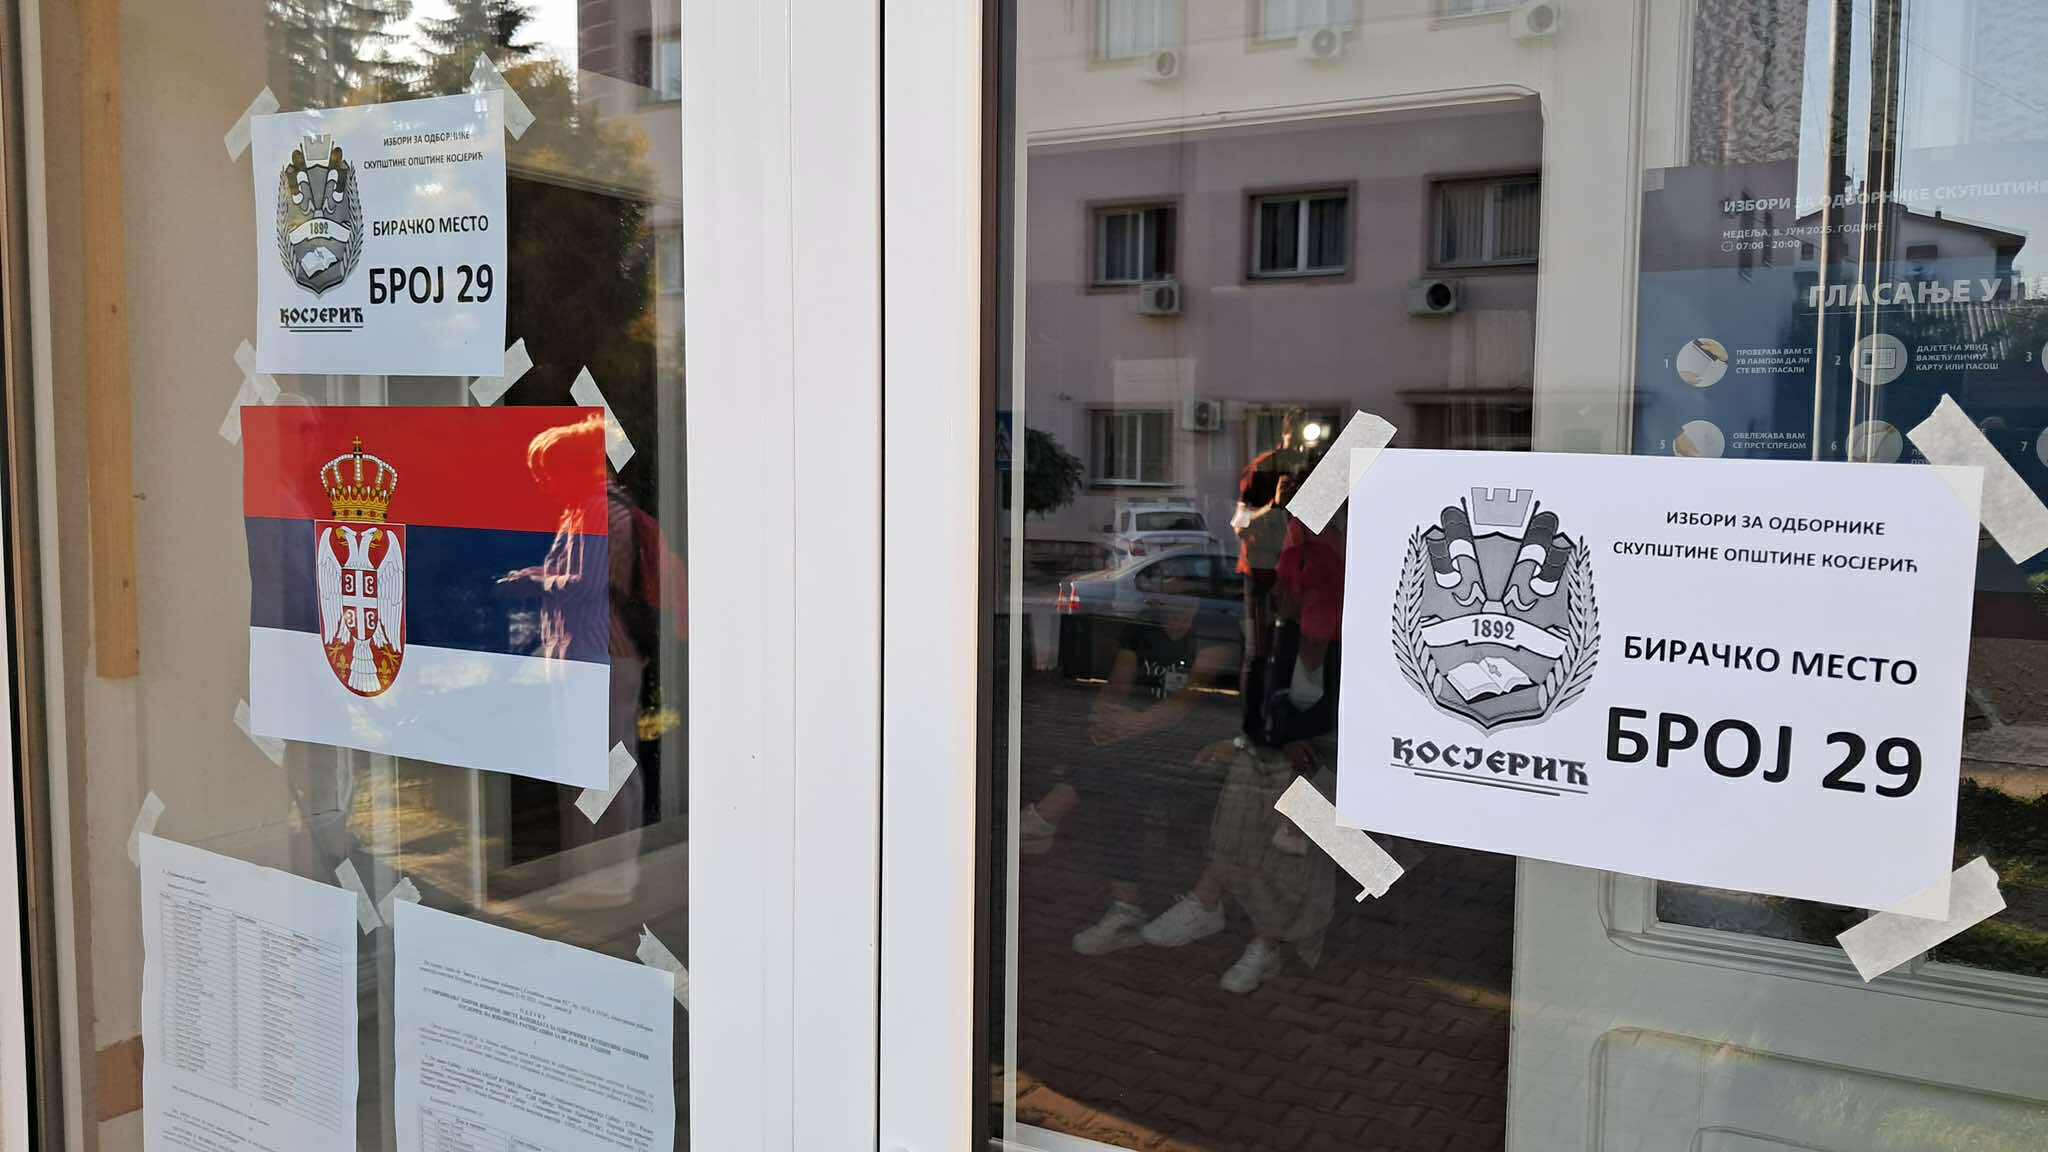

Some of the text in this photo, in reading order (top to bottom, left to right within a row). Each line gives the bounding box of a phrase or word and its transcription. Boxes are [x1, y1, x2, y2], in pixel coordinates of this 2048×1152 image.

[384, 136, 412, 146] ИЗБОРИ
[414, 136, 422, 144] ЗА
[363, 151, 483, 169] СКУПШТИНЕ ОПШТИНЕ КОСЈЕРИЋ
[1723, 197, 1791, 214] ИЗБОРИ
[1932, 180, 2048, 203] СКУПШТИНЕ
[310, 222, 328, 235] 1892
[373, 215, 489, 236] БИРАЧКО МЕСТО
[1785, 225, 1804, 238] ЈУН
[1838, 222, 1884, 235] ГОДИНЕ
[1736, 240, 1764, 251] 07:00
[1771, 239, 1800, 250] 20:00
[369, 264, 493, 304] БРОЈ 29
[1808, 281, 1970, 308] ГЛАСАЊЕ
[1979, 279, 2002, 302] У
[280, 307, 363, 326] КОСЈЕРИЋ
[1917, 344, 1988, 353] ДАЈЕТЕ НА УВИД
[1785, 357, 1797, 365] ДА
[1834, 356, 1841, 366] 2
[1916, 354, 1953, 362] ВАЖЕЋУ
[2026, 352, 2032, 362] 3
[1664, 359, 1669, 368] 1
[1915, 363, 1944, 371] КАРТУ
[1966, 362, 1999, 370] ПАСОШ
[1768, 366, 1804, 374] ГЛАСАЛИ
[1733, 432, 1785, 440] ОБЕЛЕЖАВА
[1660, 440, 1665, 449] 5
[1831, 441, 1837, 450] 6
[2021, 441, 2027, 451] 7
[1666, 511, 1886, 536] ИЗБОРИ ЗА ОДБОРНИКЕ
[1613, 541, 1918, 573] СКУПШТИНЕ ОПШТИНЕ КОСЈЕРИЋ
[1471, 618, 1516, 640] 1892
[1624, 635, 1918, 685] БИРАЧКО МЕСТО
[1606, 705, 1922, 798] БРОЈ 29
[1391, 736, 1588, 786] КОСЈЕРИЋ
